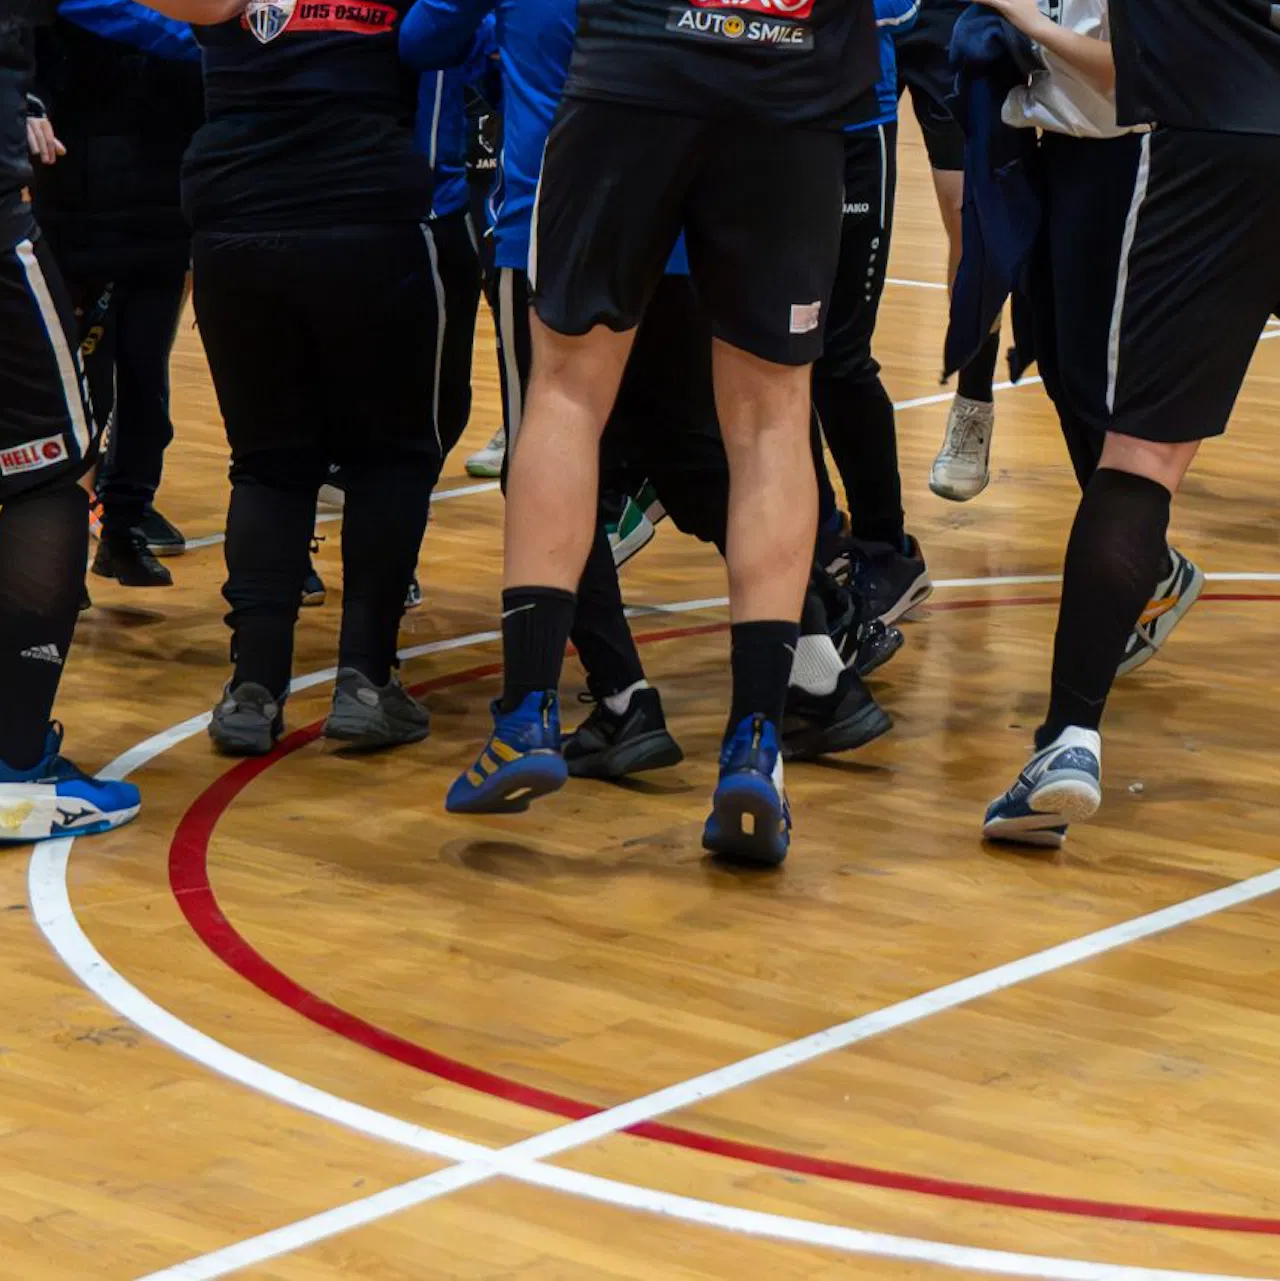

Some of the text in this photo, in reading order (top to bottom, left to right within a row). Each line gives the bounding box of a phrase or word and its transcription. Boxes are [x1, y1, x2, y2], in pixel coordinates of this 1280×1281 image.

[300, 3, 330, 20] U15
[747, 22, 804, 44] SMILE
[475, 158, 498, 170] JAK
